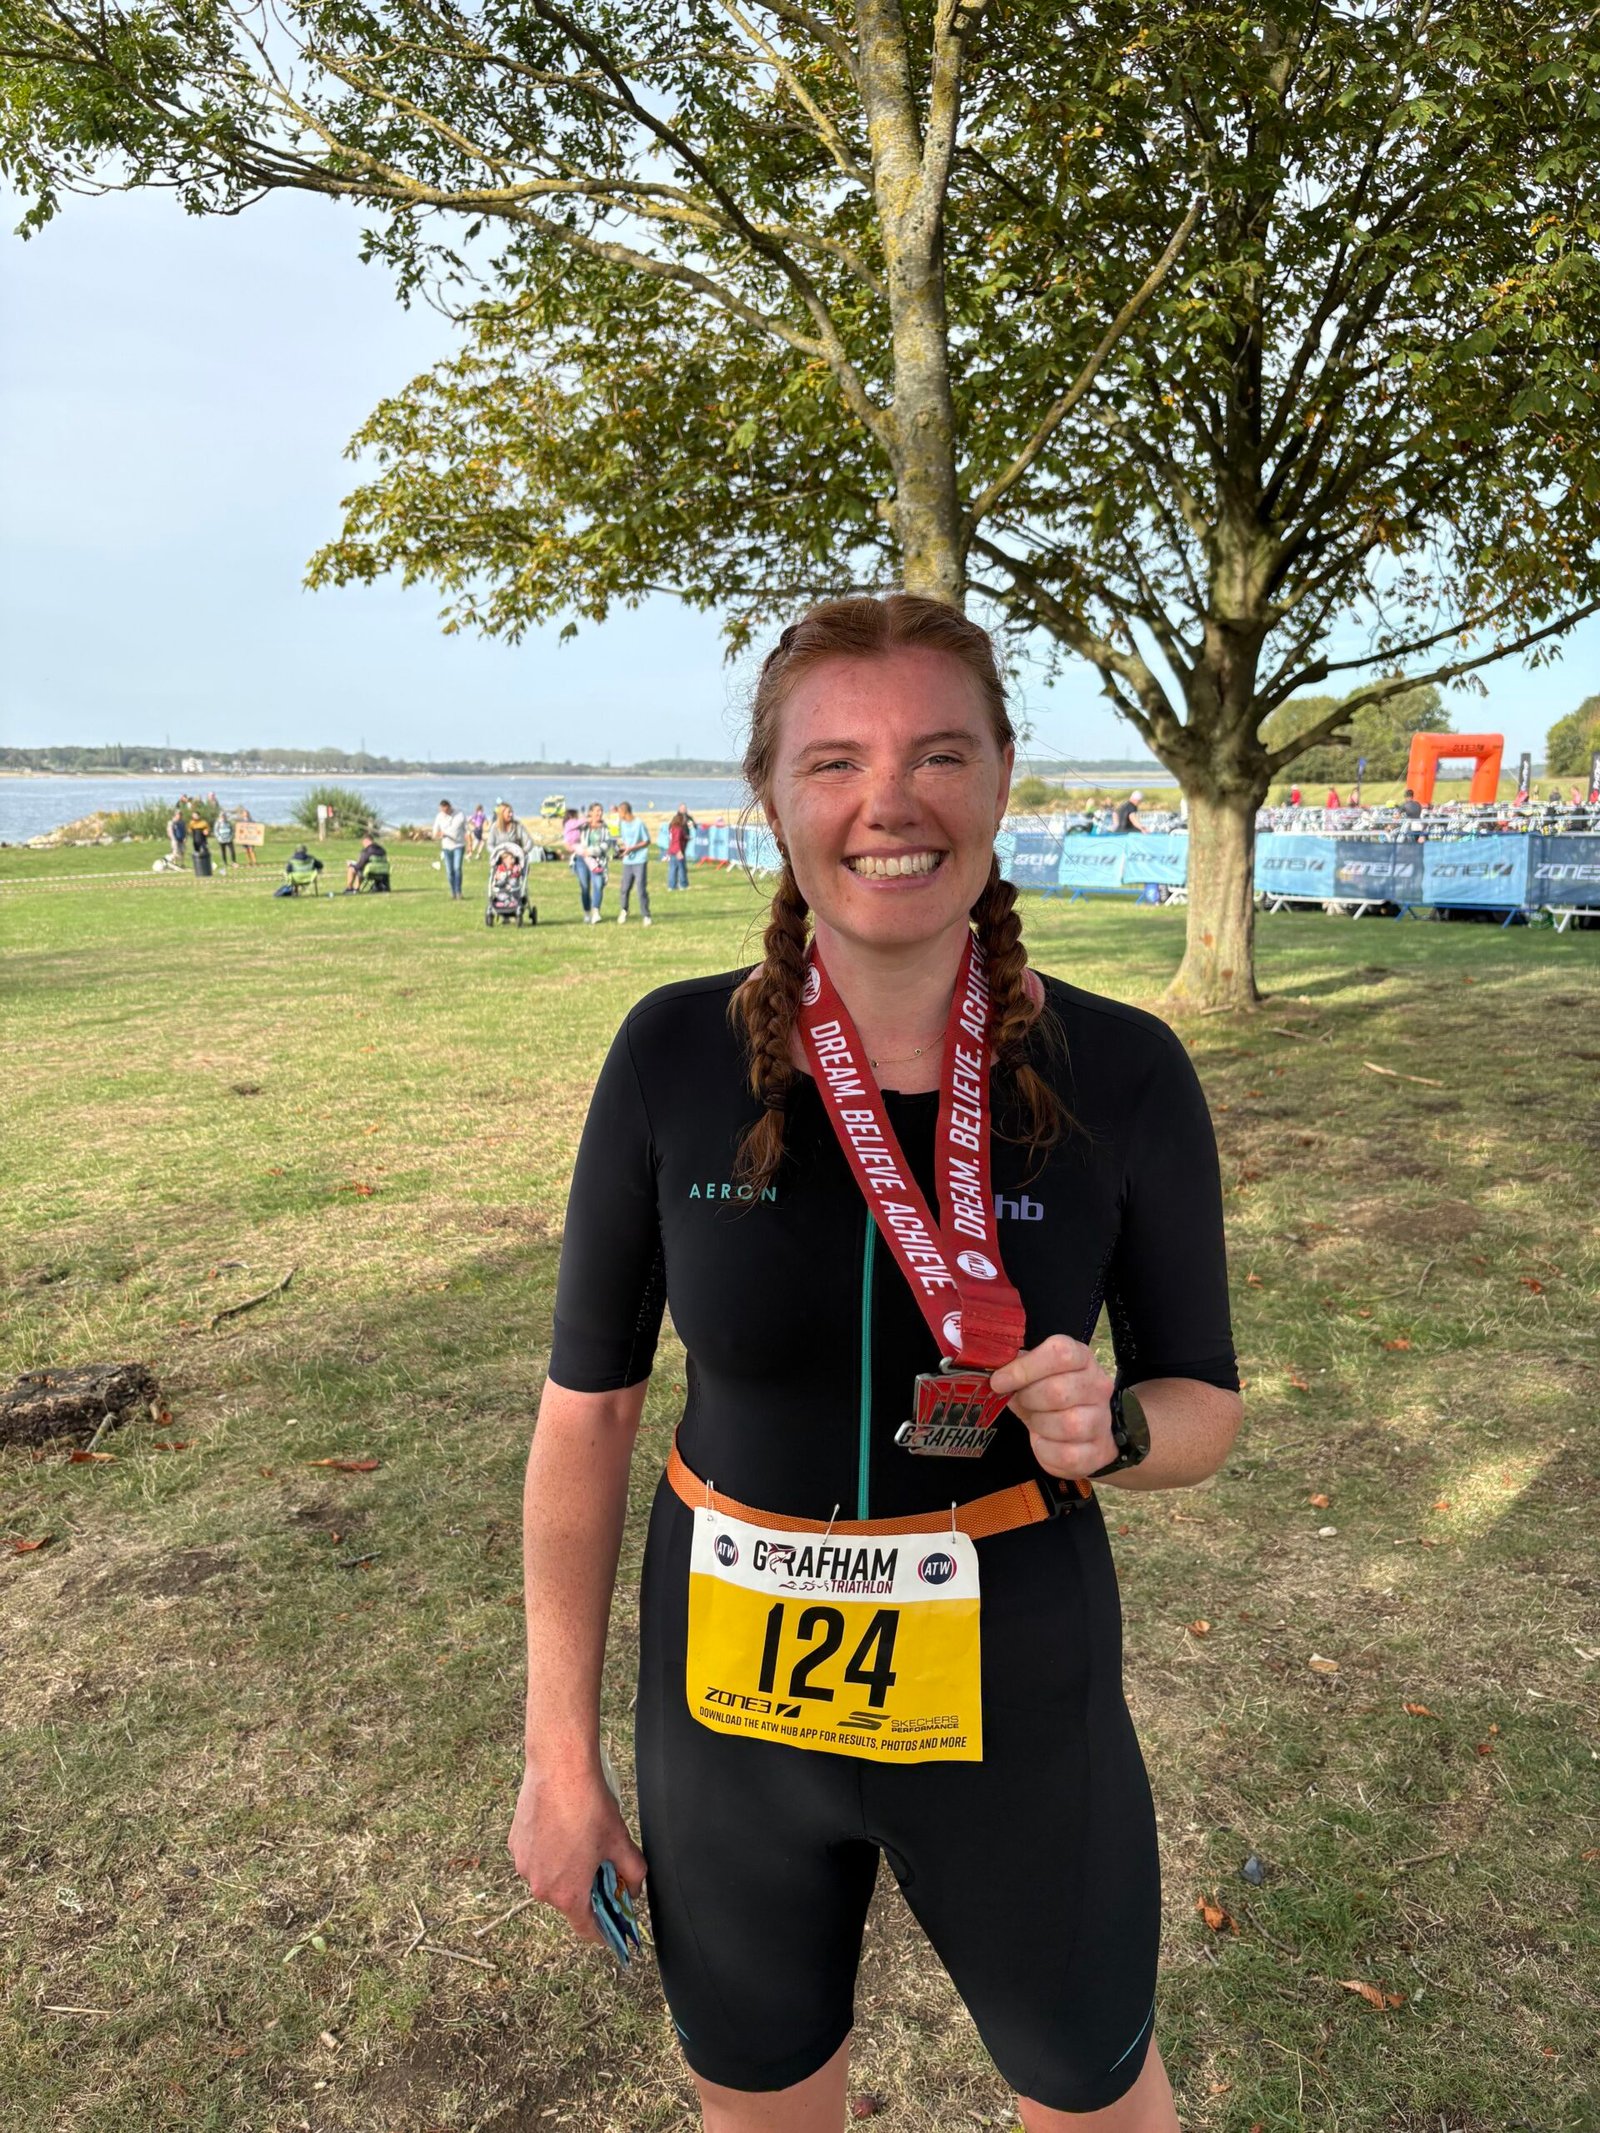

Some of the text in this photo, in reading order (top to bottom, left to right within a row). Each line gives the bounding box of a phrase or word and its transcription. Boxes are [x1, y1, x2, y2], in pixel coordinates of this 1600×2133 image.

[949, 1044, 983, 1152] BELIEVE.
[809, 1020, 958, 1296] DREAM. BELIEVE. ACHIEVE.
[689, 1183, 777, 1202] AERON
[949, 1158, 987, 1241] DREAM.
[717, 1541, 735, 1560] ATW
[753, 1539, 899, 1581] GRAFHAM
[924, 1561, 951, 1576] ATW
[831, 1579, 893, 1594] TRIATHLON
[758, 1602, 900, 1709] 124
[704, 1687, 772, 1714] ZONE3
[699, 1706, 967, 1751] DOWNLOAD THE ATW HUB APP FOR RESULTS, PHOTOS AND MORE
[891, 1715, 959, 1728] SKECHERS
[891, 1723, 959, 1733] PERFORMANCE
